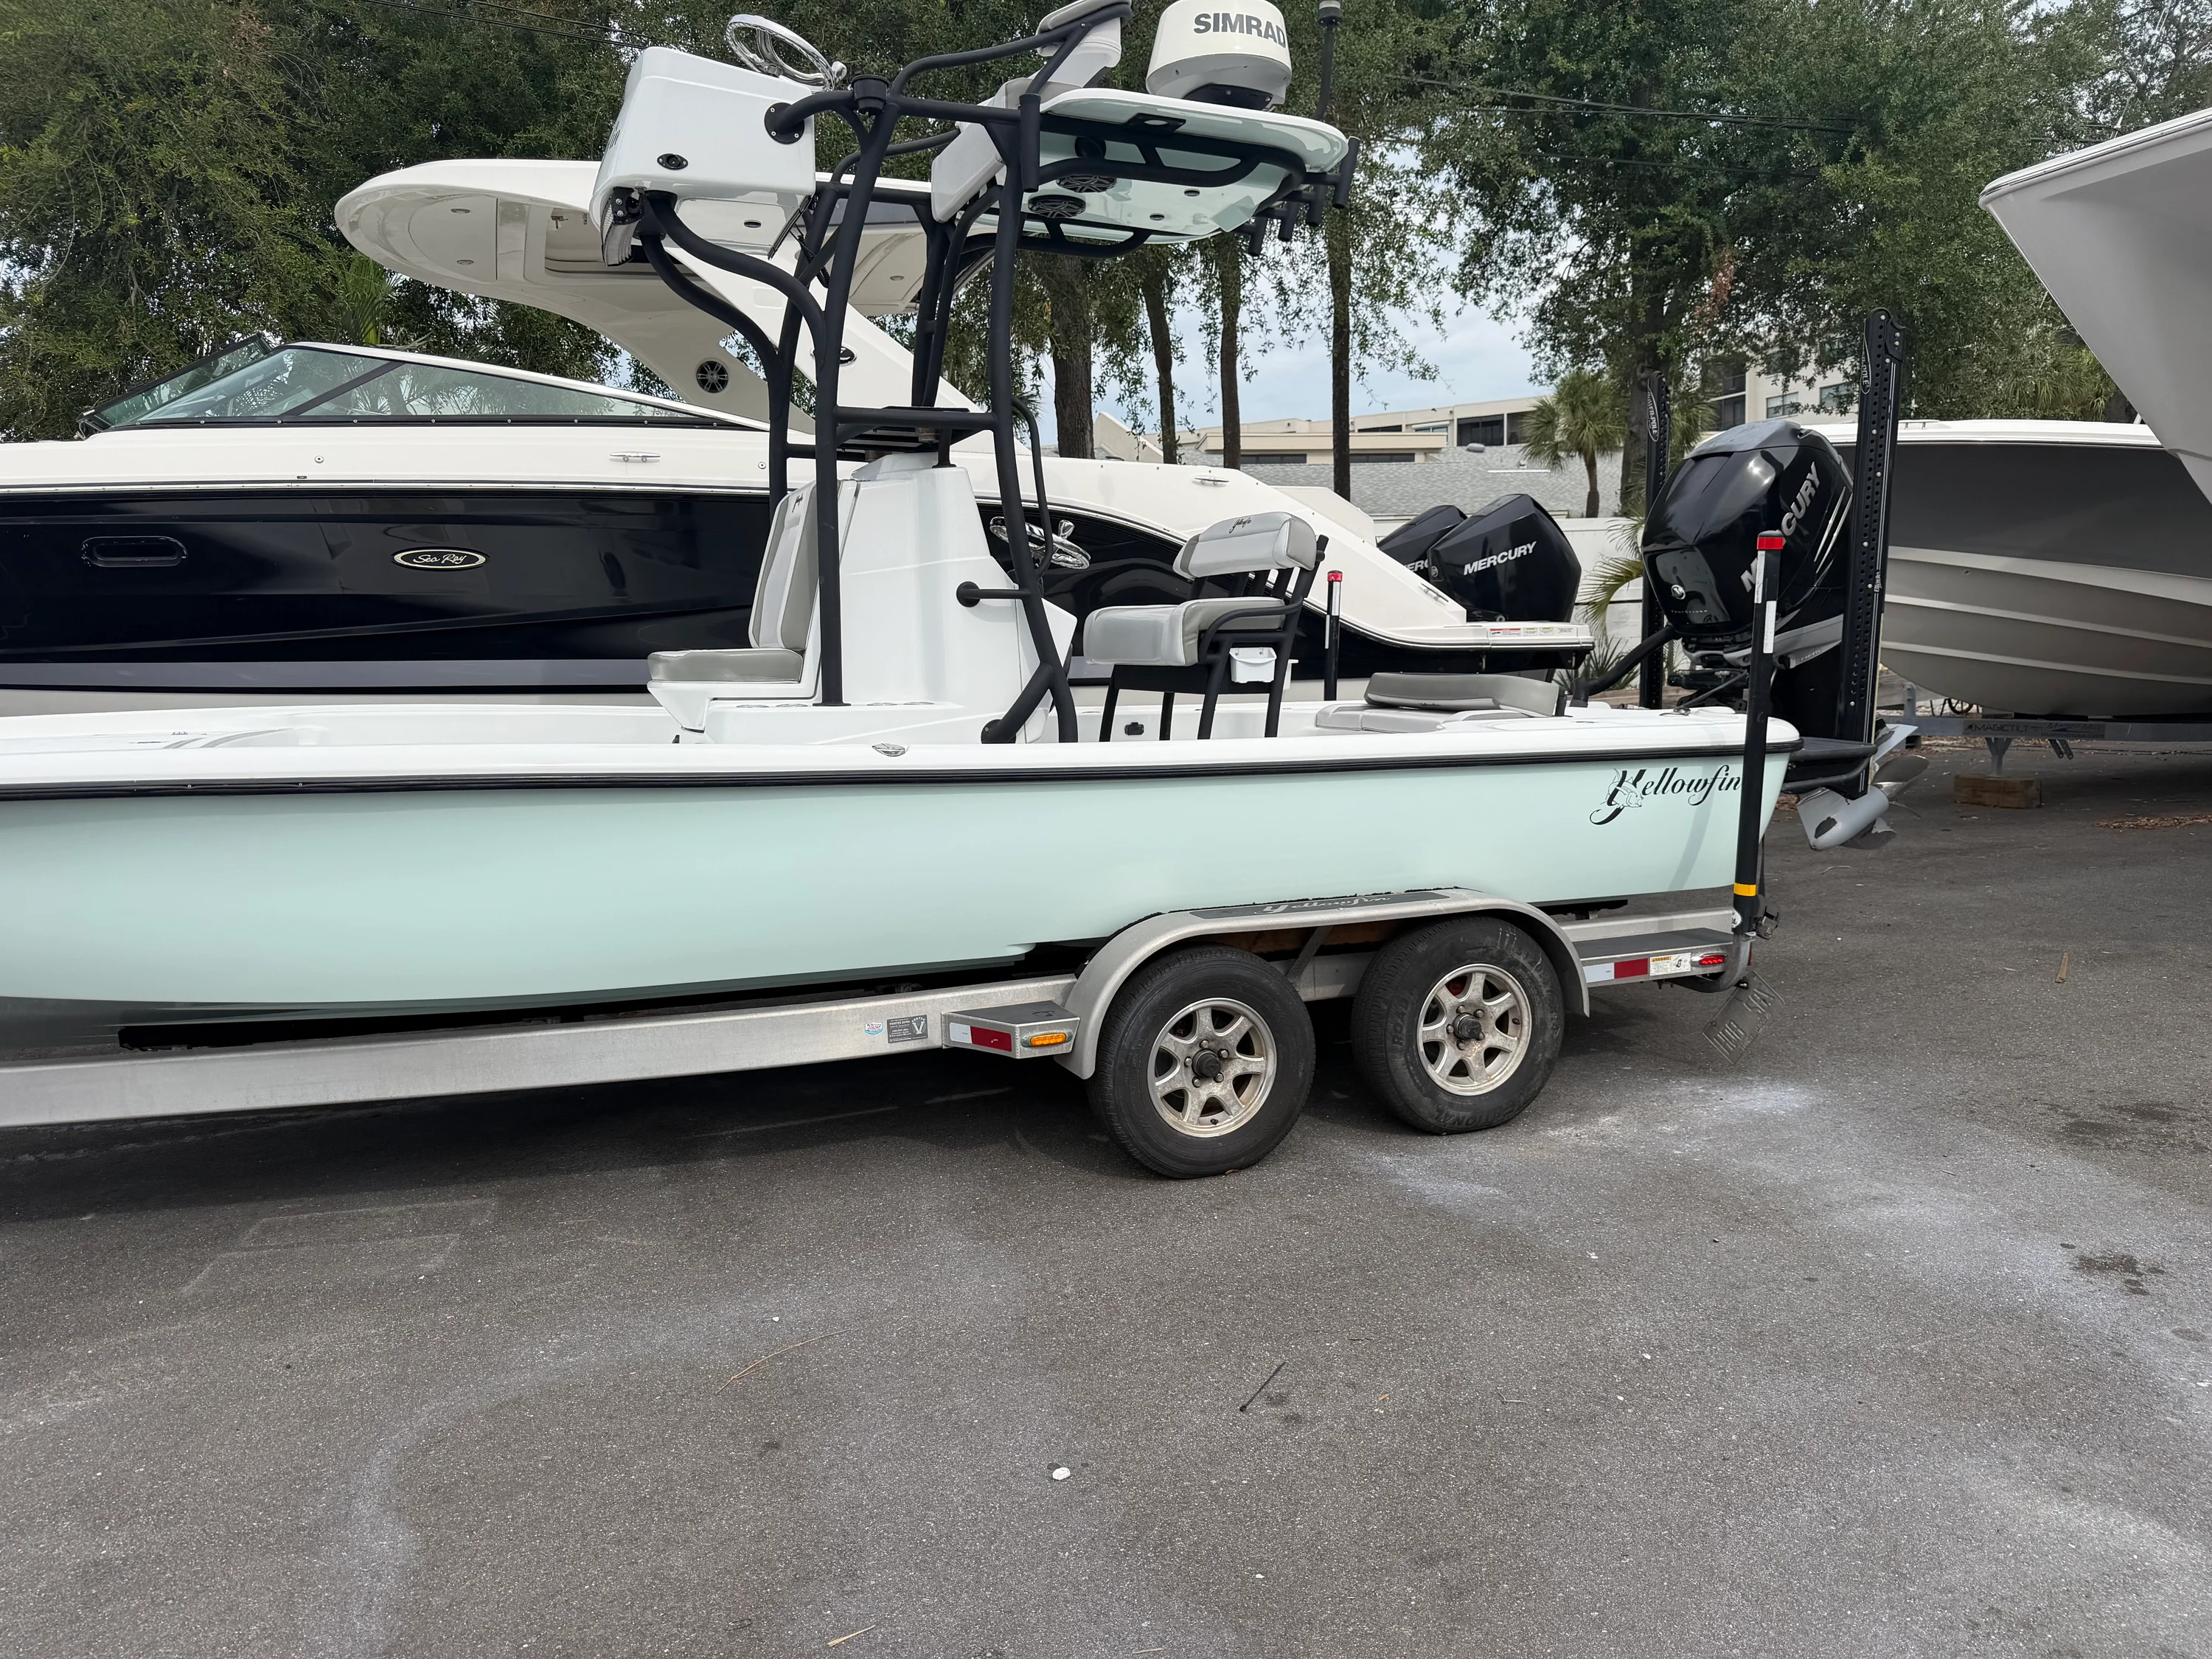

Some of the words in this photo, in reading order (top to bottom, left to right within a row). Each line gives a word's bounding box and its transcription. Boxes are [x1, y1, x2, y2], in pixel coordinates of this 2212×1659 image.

[1194, 13, 1286, 49] SIMRAD
[1740, 461, 1820, 593] MCURY
[413, 554, 440, 563] Sea
[441, 554, 467, 564] Ray
[1464, 541, 1537, 575] MERCURY
[1590, 765, 1741, 825] Yellowfin
